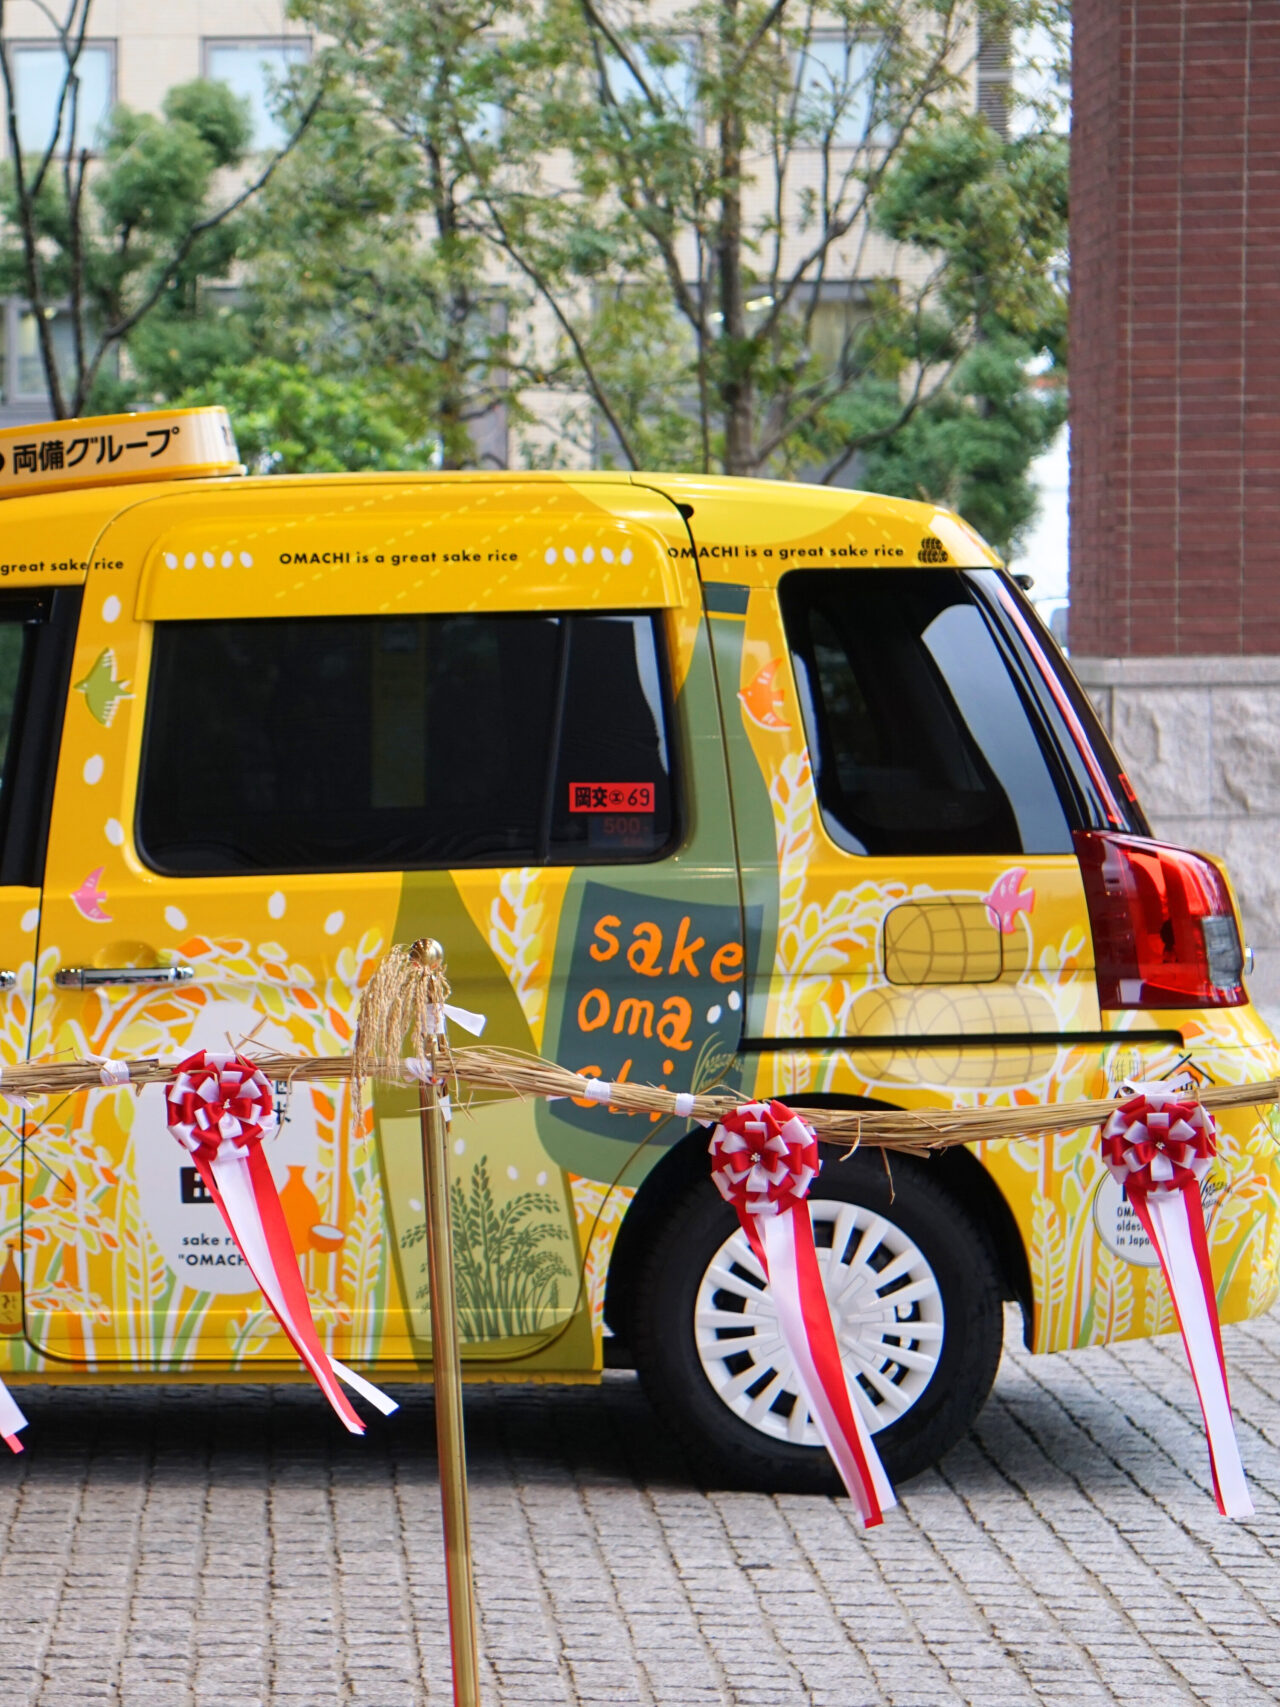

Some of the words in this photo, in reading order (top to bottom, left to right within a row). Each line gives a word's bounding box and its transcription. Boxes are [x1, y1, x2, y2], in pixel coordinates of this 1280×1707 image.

[12, 426, 181, 475] 両備グループ
[278, 551, 351, 566] OMACHI
[356, 551, 370, 565] is
[375, 553, 385, 564] a
[391, 551, 437, 567] great
[442, 549, 482, 563] sake
[487, 549, 519, 563] rice
[667, 545, 739, 560] OMACHI
[744, 544, 758, 558] is
[763, 547, 773, 558] a
[779, 546, 824, 561] great
[830, 544, 869, 558] sake
[874, 544, 905, 558] rice
[0, 561, 45, 577] great
[50, 558, 90, 572] sake
[94, 557, 125, 571] rice
[589, 914, 745, 984] sake
[577, 988, 694, 1052] oma
[182, 1232, 220, 1247] sake
[1128, 1234, 1152, 1248] Japa
